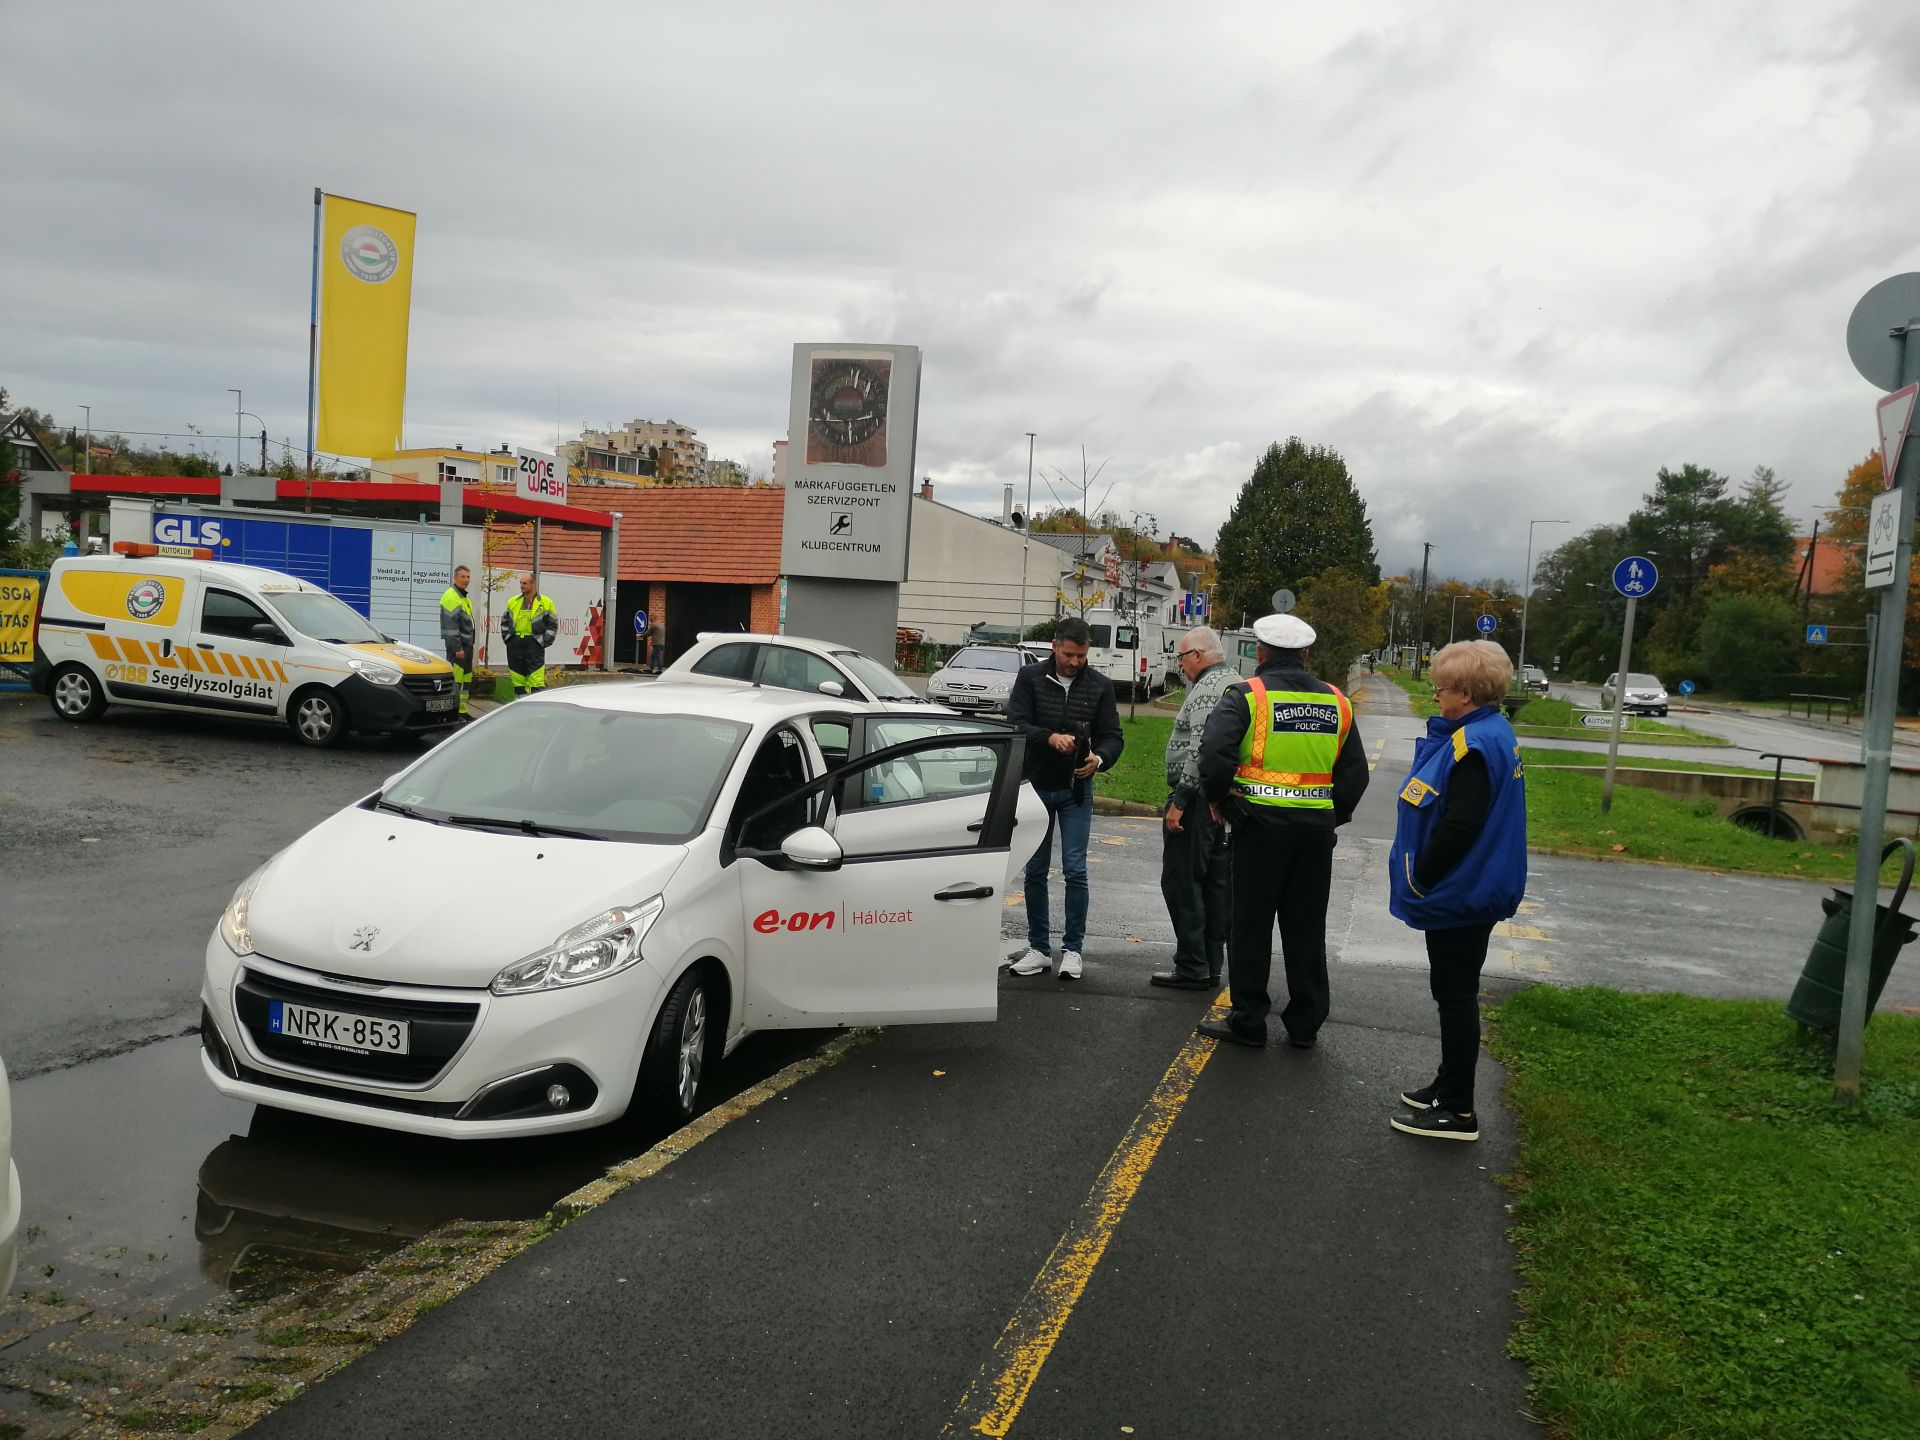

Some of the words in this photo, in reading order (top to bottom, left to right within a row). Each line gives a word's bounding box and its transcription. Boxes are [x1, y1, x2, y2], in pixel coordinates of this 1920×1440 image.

[520, 455, 554, 479] ZONE
[528, 474, 565, 498] WASH
[794, 479, 896, 493] MÁRKAFÜGGETLEN
[807, 495, 881, 507] SZERVIZPONT
[161, 546, 192, 556] AUTOKLUB
[801, 540, 881, 553] KLUBCENTRUM
[371, 575, 410, 583] csomagodat
[117, 664, 148, 684] 188
[151, 669, 274, 700] Segélyszolgálat
[1295, 722, 1321, 731] POLICE
[1243, 786, 1280, 796] OLICE
[1284, 787, 1324, 798] POLICE
[852, 908, 913, 926] Hálózat
[272, 1018, 280, 1029] H
[287, 1006, 401, 1050] NRK-853
